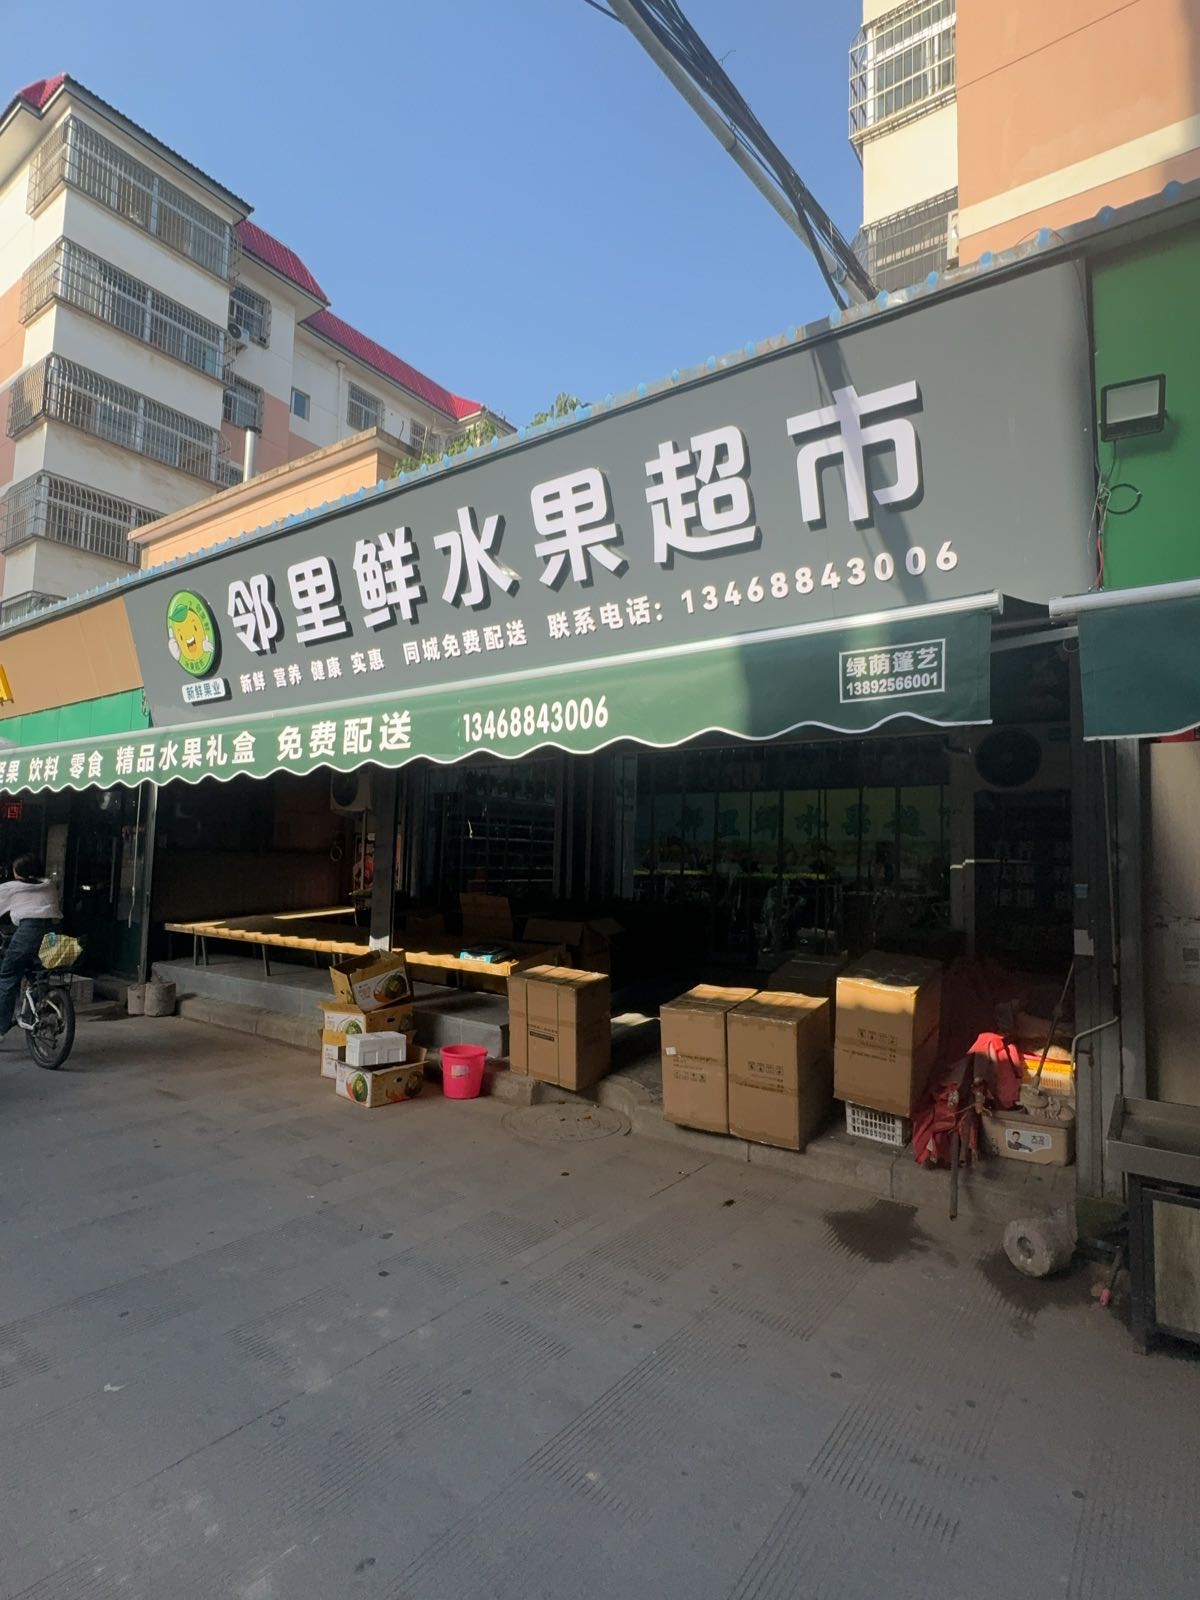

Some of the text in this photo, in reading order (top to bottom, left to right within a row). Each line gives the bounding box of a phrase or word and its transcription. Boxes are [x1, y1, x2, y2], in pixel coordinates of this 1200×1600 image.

[226, 380, 922, 655] 邻里鲜水果超市
[186, 681, 221, 701] 新鲜果业
[239, 669, 267, 694] 新鲜
[272, 663, 303, 689] 营养
[310, 655, 343, 682] 健康
[350, 647, 386, 674] 实惠
[403, 619, 528, 666] 同城免费配送
[846, 672, 938, 696] 13892566001
[28, 755, 60, 782] 饮料
[69, 750, 104, 779] 零食
[115, 731, 257, 776] 精品水果礼盒
[277, 709, 413, 762] 免费配送
[462, 695, 610, 743] 13468843006
